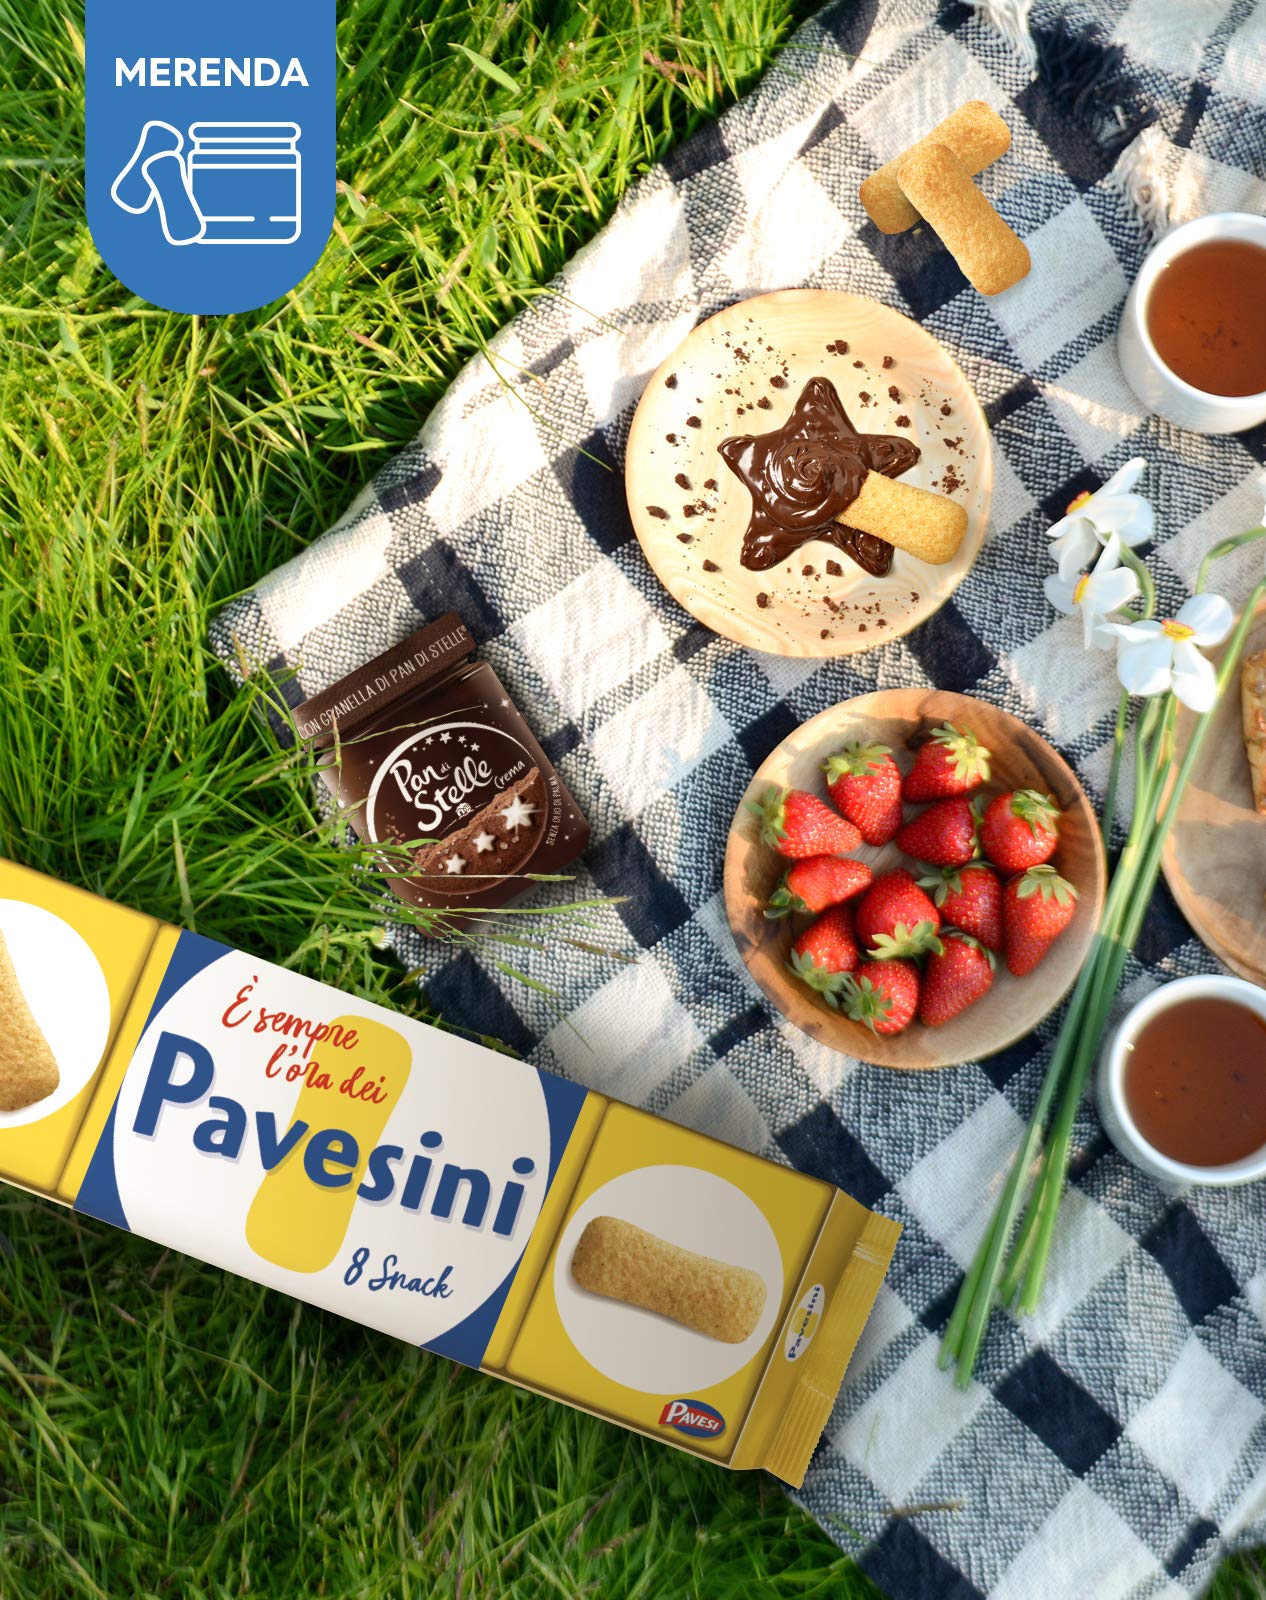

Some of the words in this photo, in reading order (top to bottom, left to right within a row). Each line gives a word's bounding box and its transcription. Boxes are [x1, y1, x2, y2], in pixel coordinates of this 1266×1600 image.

[298, 717, 322, 741] CON
[320, 684, 377, 726] GRANELLA
[375, 674, 391, 692] DI
[389, 660, 417, 684] PAN
[414, 651, 430, 667] DI
[389, 759, 450, 803] Pan
[440, 762, 453, 774] di
[414, 755, 494, 832] Stelle
[494, 760, 526, 789] Crema
[222, 975, 260, 1028] È
[253, 1008, 360, 1058] sempre
[339, 1066, 390, 1105] dei
[131, 1030, 536, 1237] Pavesini
[344, 1247, 370, 1286] 8
[367, 1254, 454, 1299] Snack
[787, 1286, 821, 1359] Pavesini
